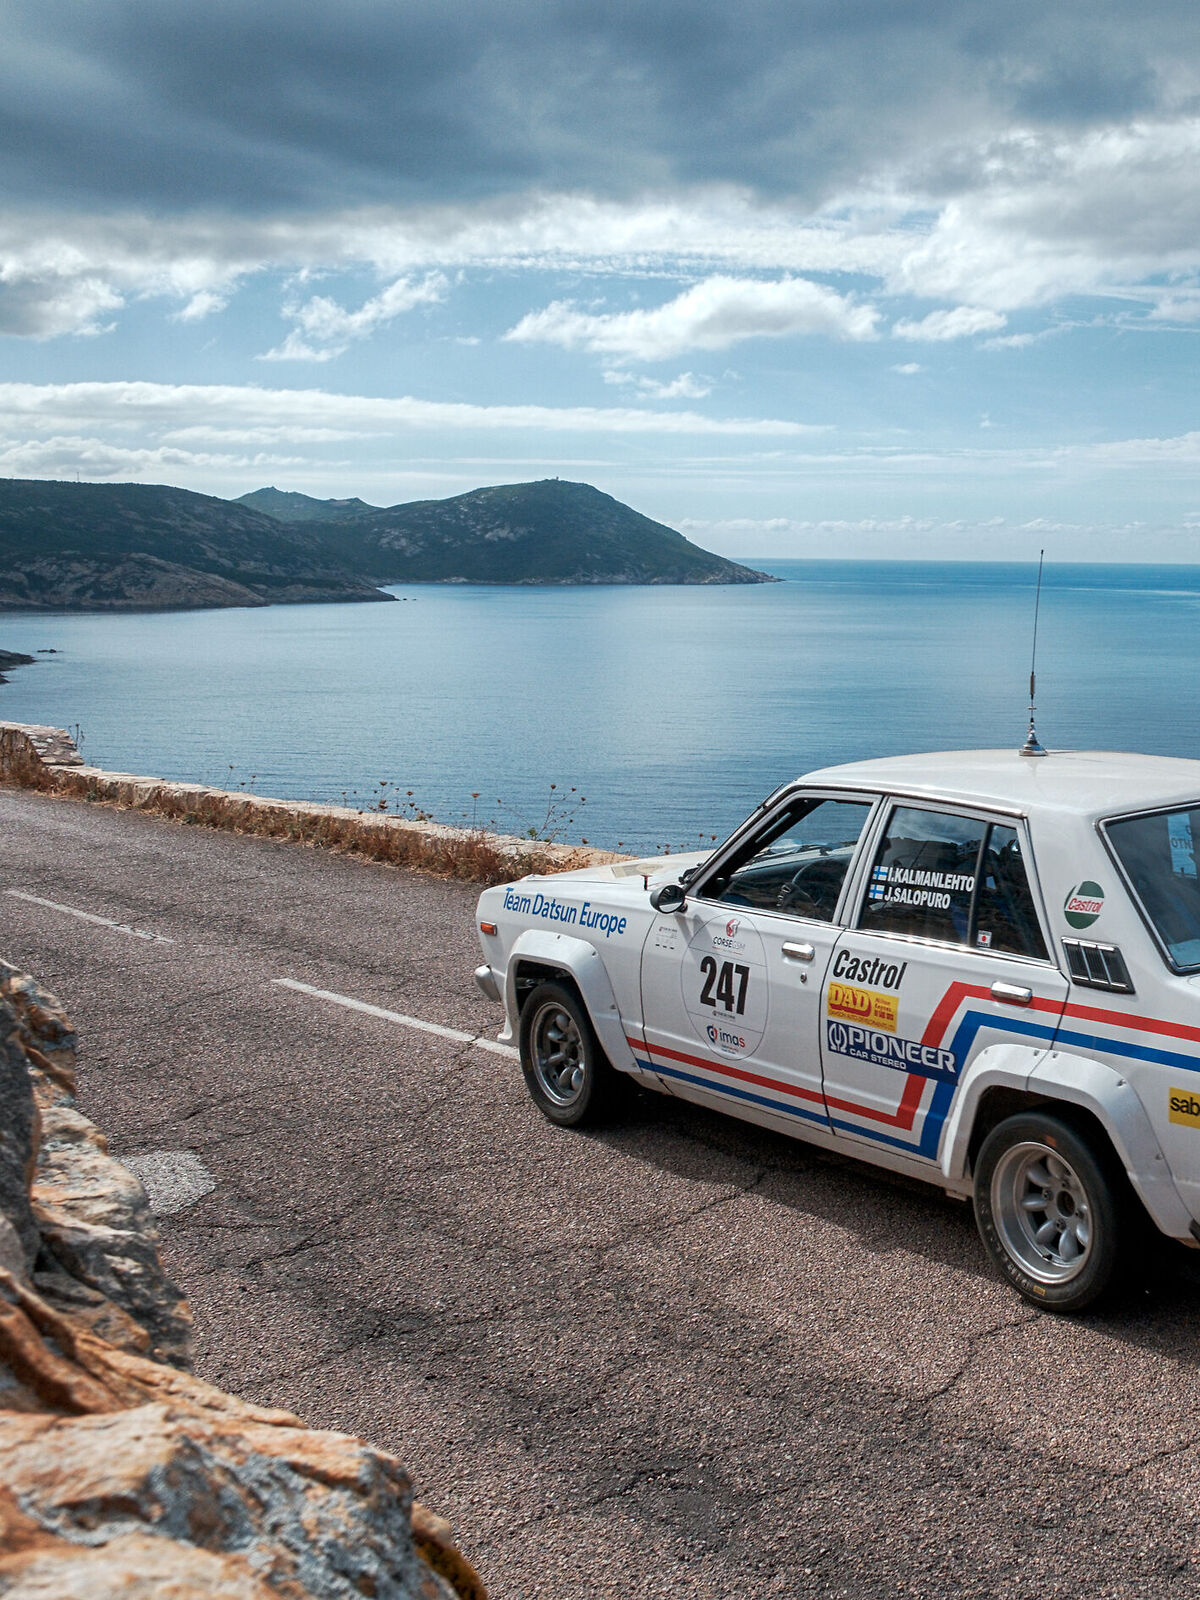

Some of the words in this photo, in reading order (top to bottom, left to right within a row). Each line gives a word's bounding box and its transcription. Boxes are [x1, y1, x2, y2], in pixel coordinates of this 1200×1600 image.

[888, 867, 975, 892] I.KALMANLEHTO
[503, 887, 531, 914] Team
[532, 893, 577, 924] Datsun
[579, 902, 627, 938] Europe
[884, 887, 951, 910] J.SALOPURO
[1068, 898, 1104, 913] Castrol
[833, 949, 908, 990] Castrol
[700, 955, 750, 1015] 247
[829, 984, 872, 1018] DAD
[719, 1028, 745, 1048] imas
[848, 1027, 956, 1073] PIONEER
[849, 1048, 869, 1060] CAR
[871, 1054, 907, 1070] STEREO
